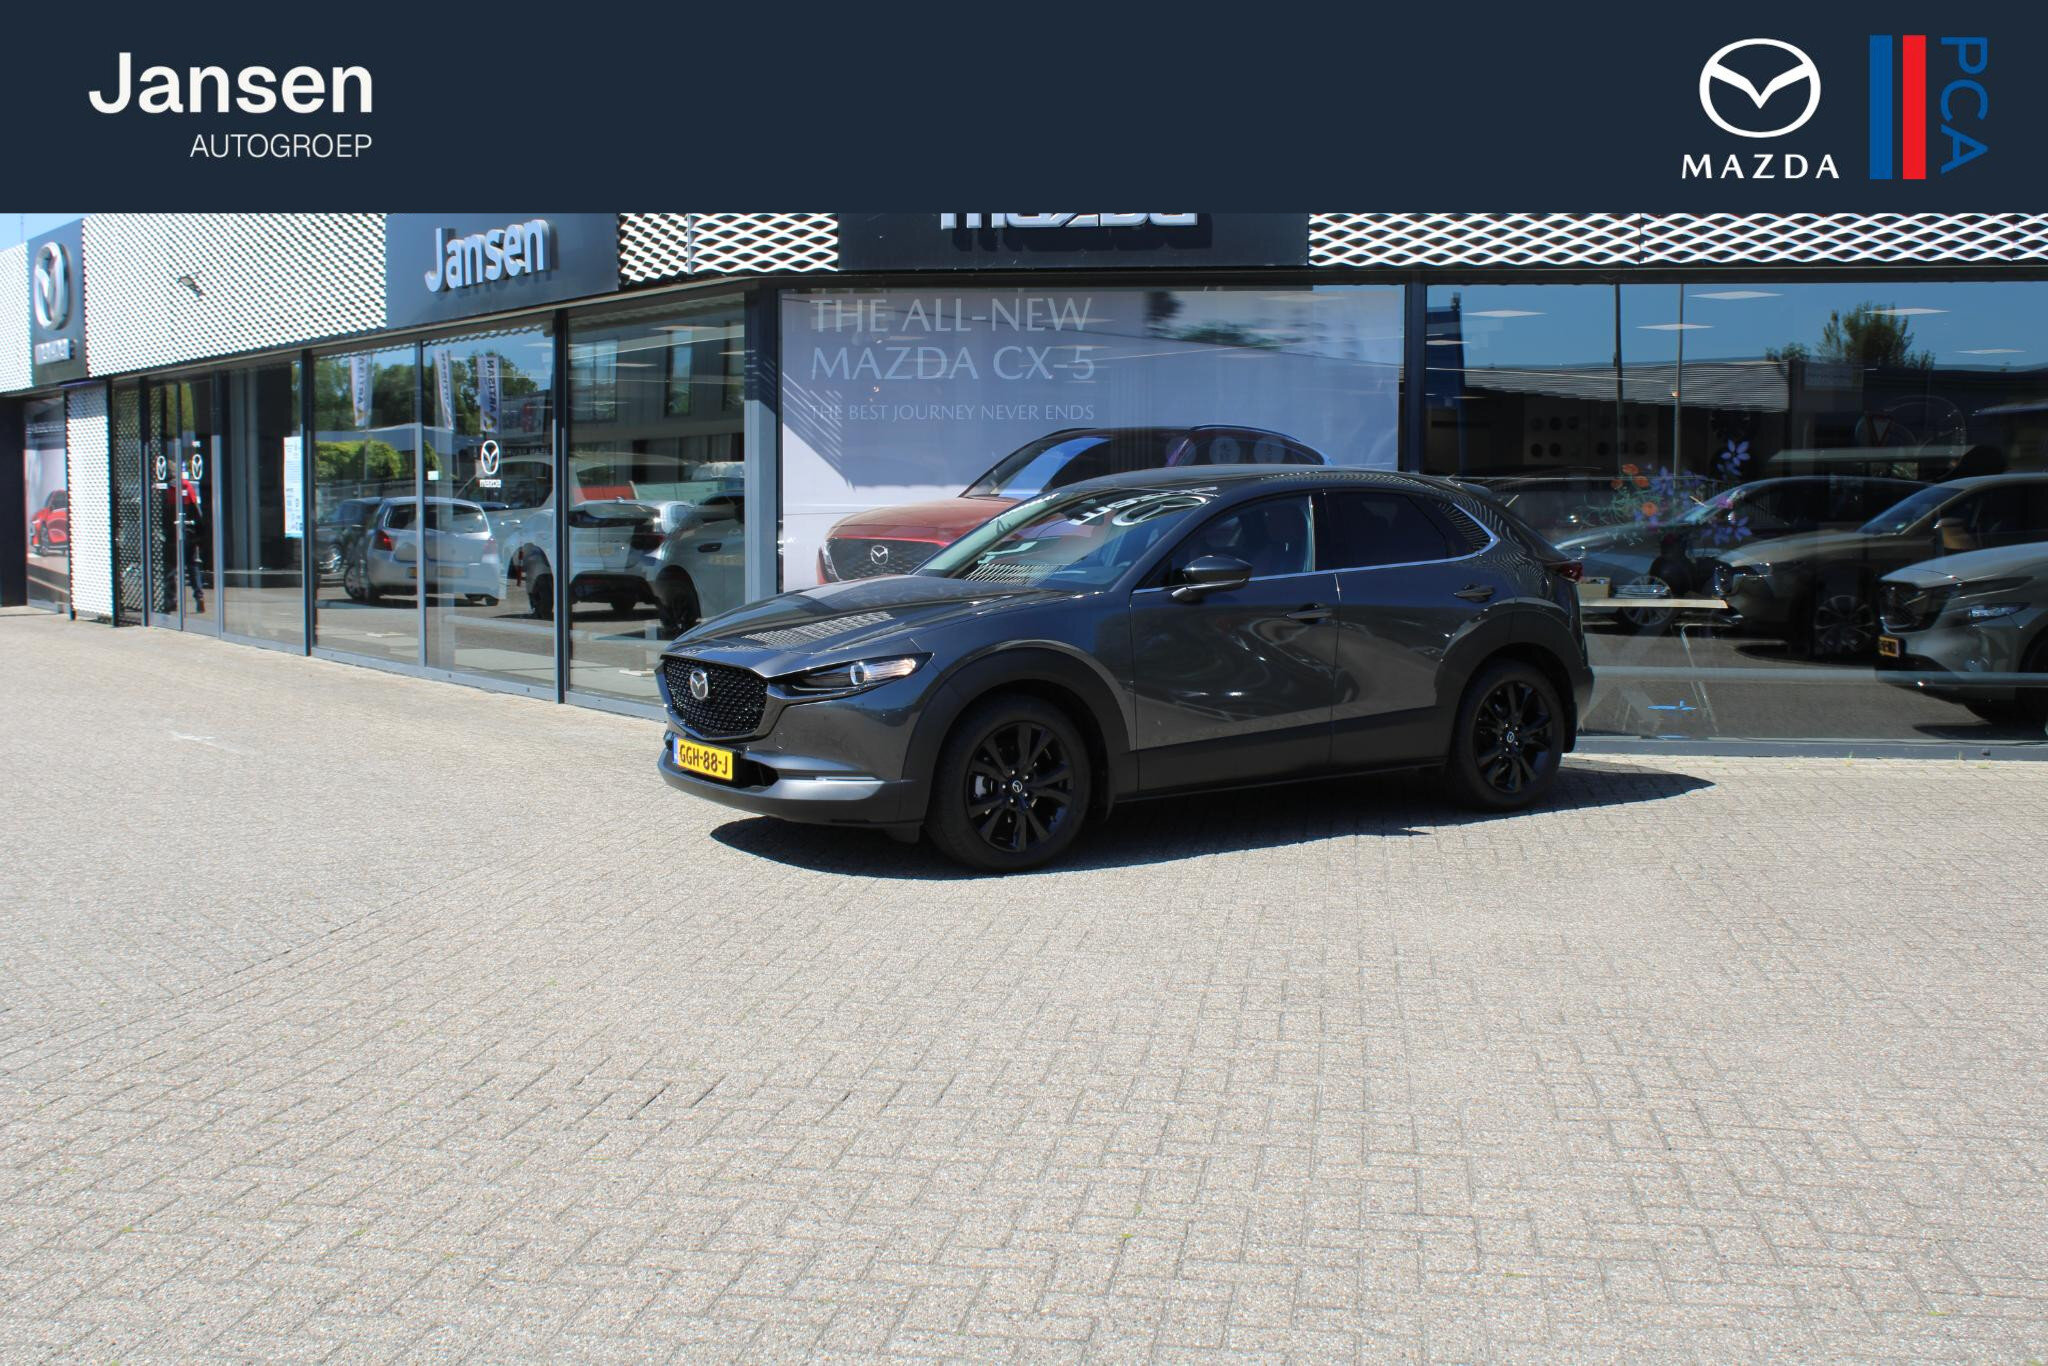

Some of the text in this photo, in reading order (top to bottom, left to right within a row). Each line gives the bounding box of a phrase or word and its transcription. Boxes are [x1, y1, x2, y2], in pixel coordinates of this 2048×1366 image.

[424, 219, 550, 293] Jansen
[810, 298, 1092, 333] THE ALL-NEW
[811, 346, 1095, 380] MAZDA CX-5
[810, 405, 1095, 421] THE BEST JOURNEY NEVER ENDS
[679, 743, 729, 776] GGH-88-J
